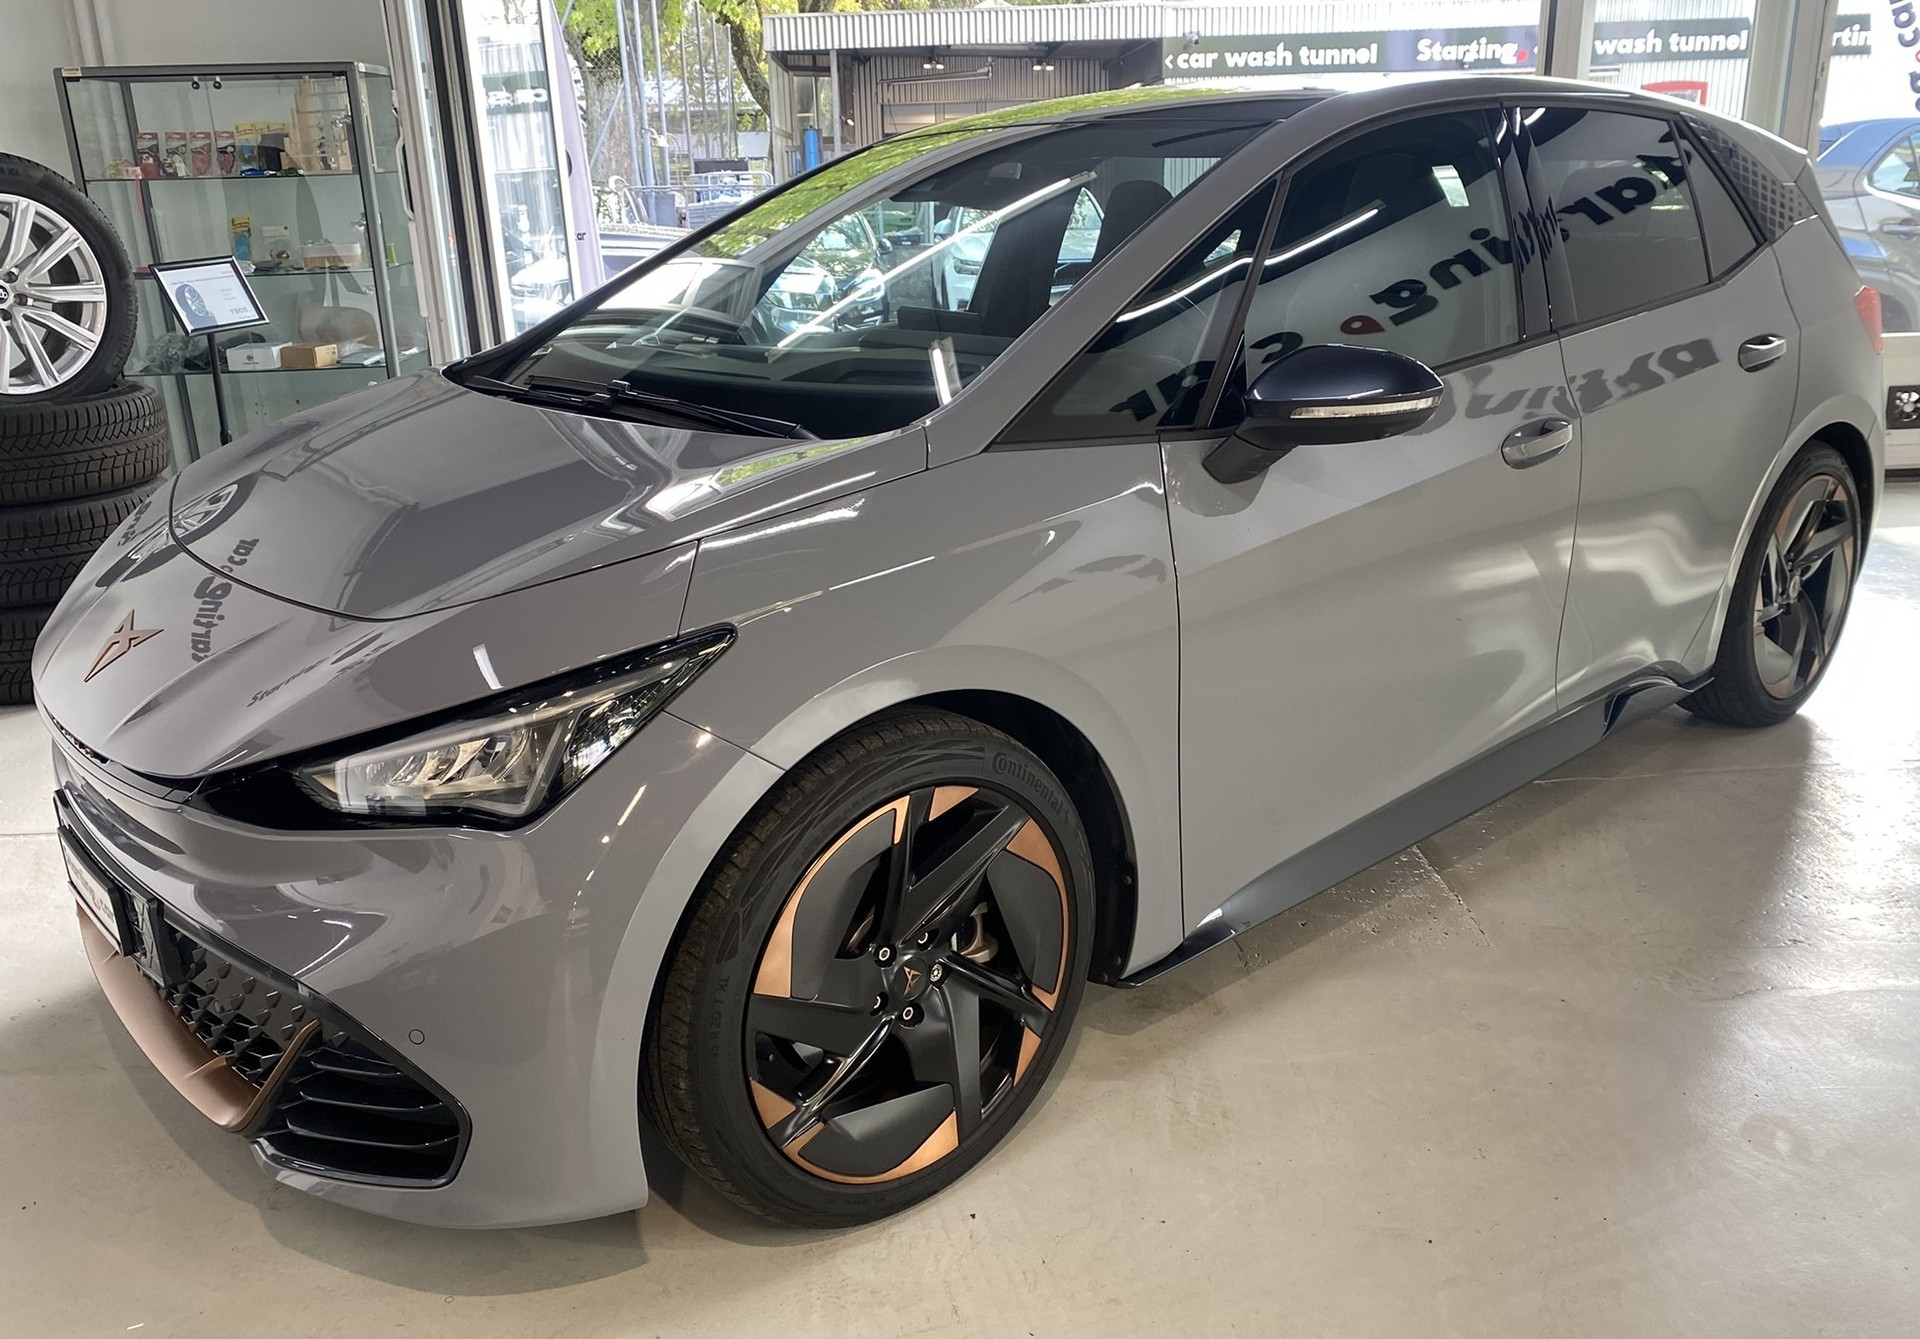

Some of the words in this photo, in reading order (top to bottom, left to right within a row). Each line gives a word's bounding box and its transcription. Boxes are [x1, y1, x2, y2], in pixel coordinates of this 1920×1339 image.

[1176, 52, 1219, 69] car
[1224, 42, 1293, 67] wash
[1299, 43, 1378, 66] tunnel
[1416, 37, 1519, 65] Starting
[1594, 29, 1663, 55] wash
[1669, 29, 1749, 52] tunnel
[992, 752, 1063, 816] Continental
